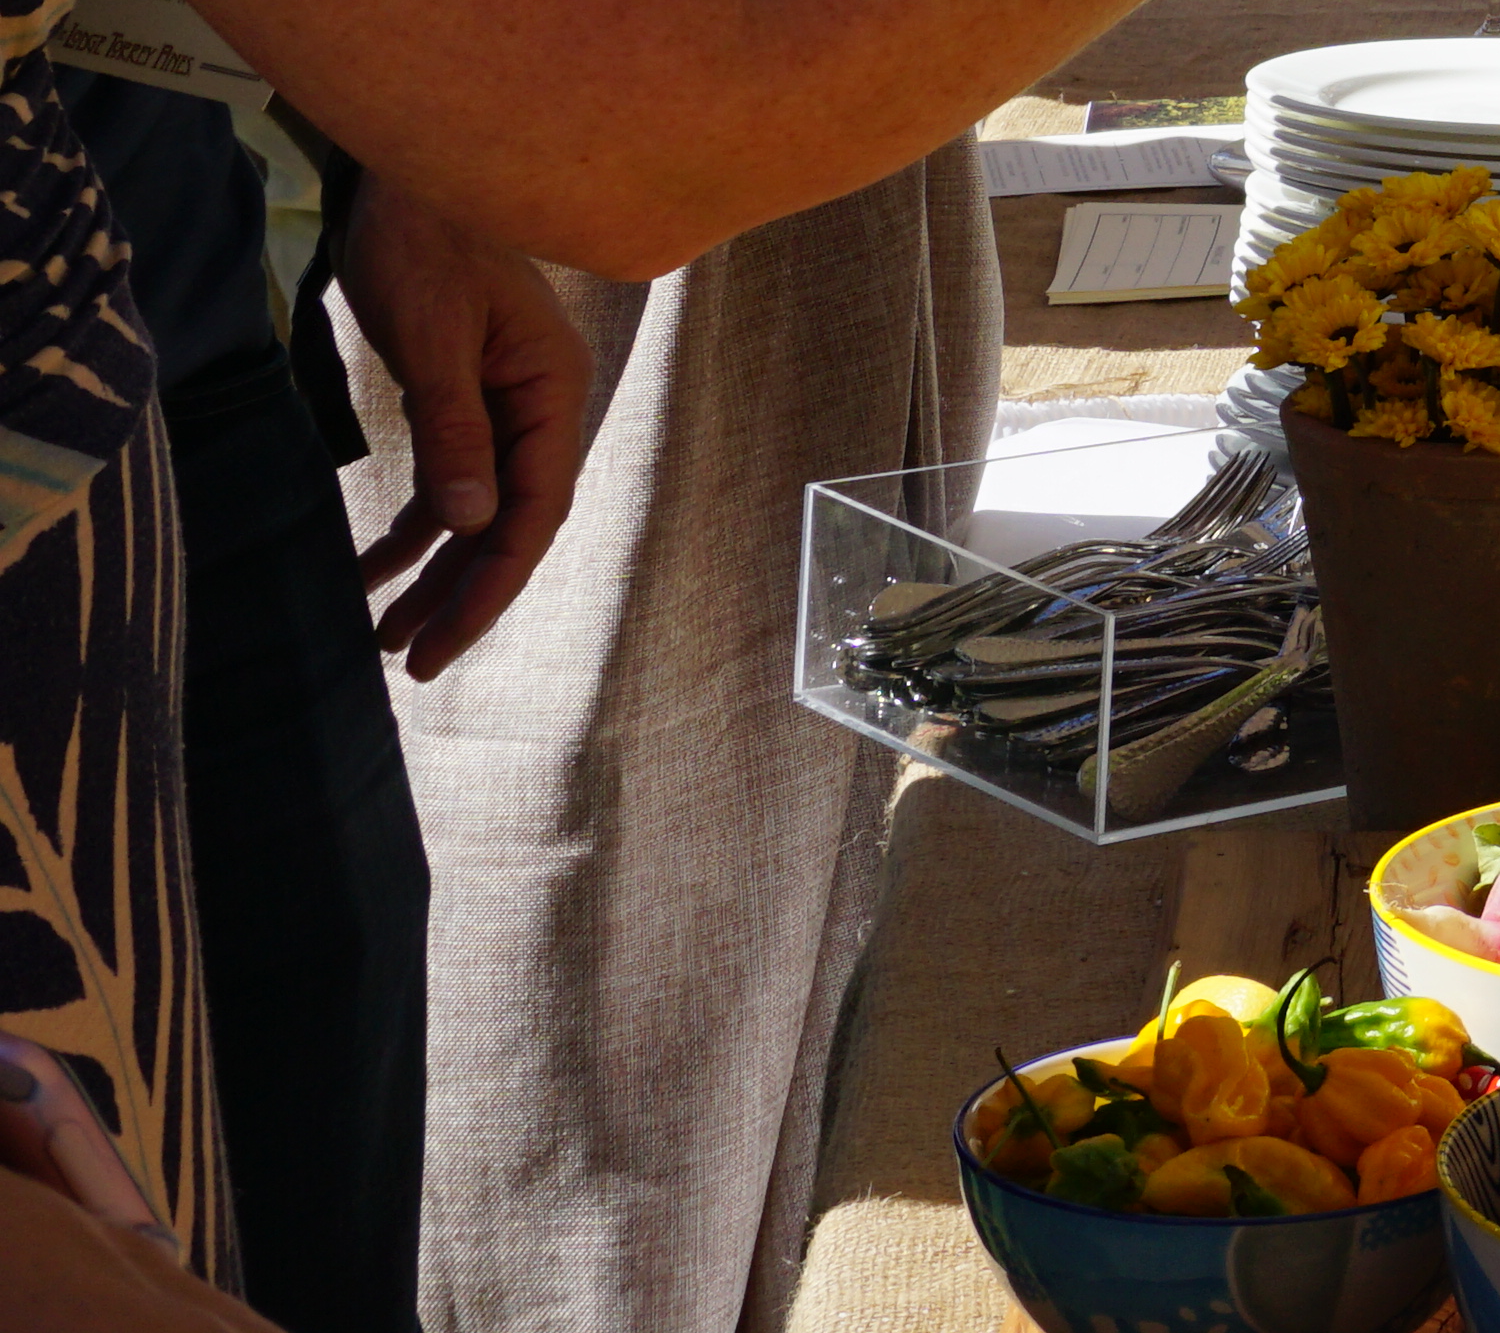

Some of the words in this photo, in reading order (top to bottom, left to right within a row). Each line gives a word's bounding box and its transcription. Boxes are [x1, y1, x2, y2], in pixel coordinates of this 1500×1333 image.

[63, 22, 107, 56] LODGE
[105, 31, 159, 67] TORREY
[152, 42, 195, 78] PINES
